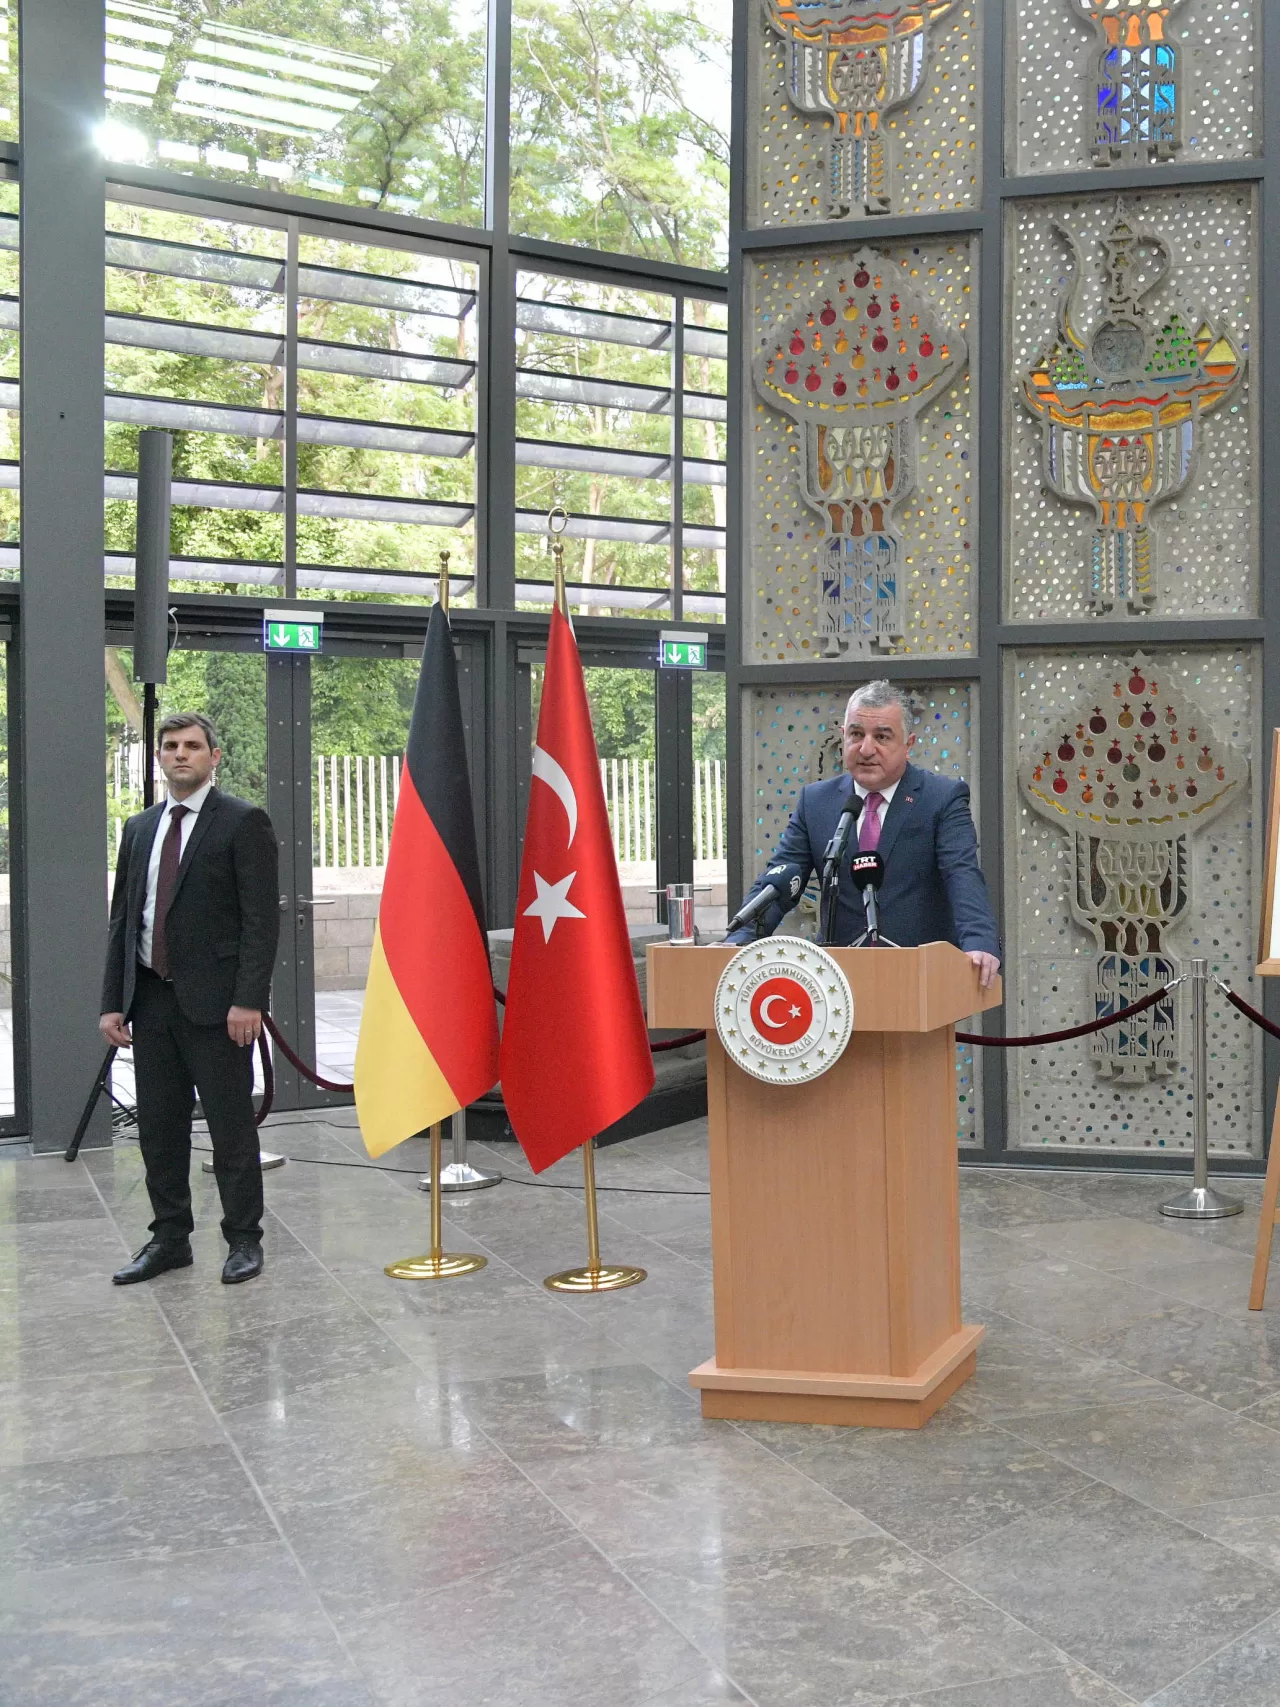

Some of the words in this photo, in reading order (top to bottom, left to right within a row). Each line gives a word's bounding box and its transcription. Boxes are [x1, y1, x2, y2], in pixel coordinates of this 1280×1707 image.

[853, 856, 876, 865] TRT
[741, 971, 768, 1003] TÜRKİYE
[768, 967, 823, 1005] CUMHURİYETİ
